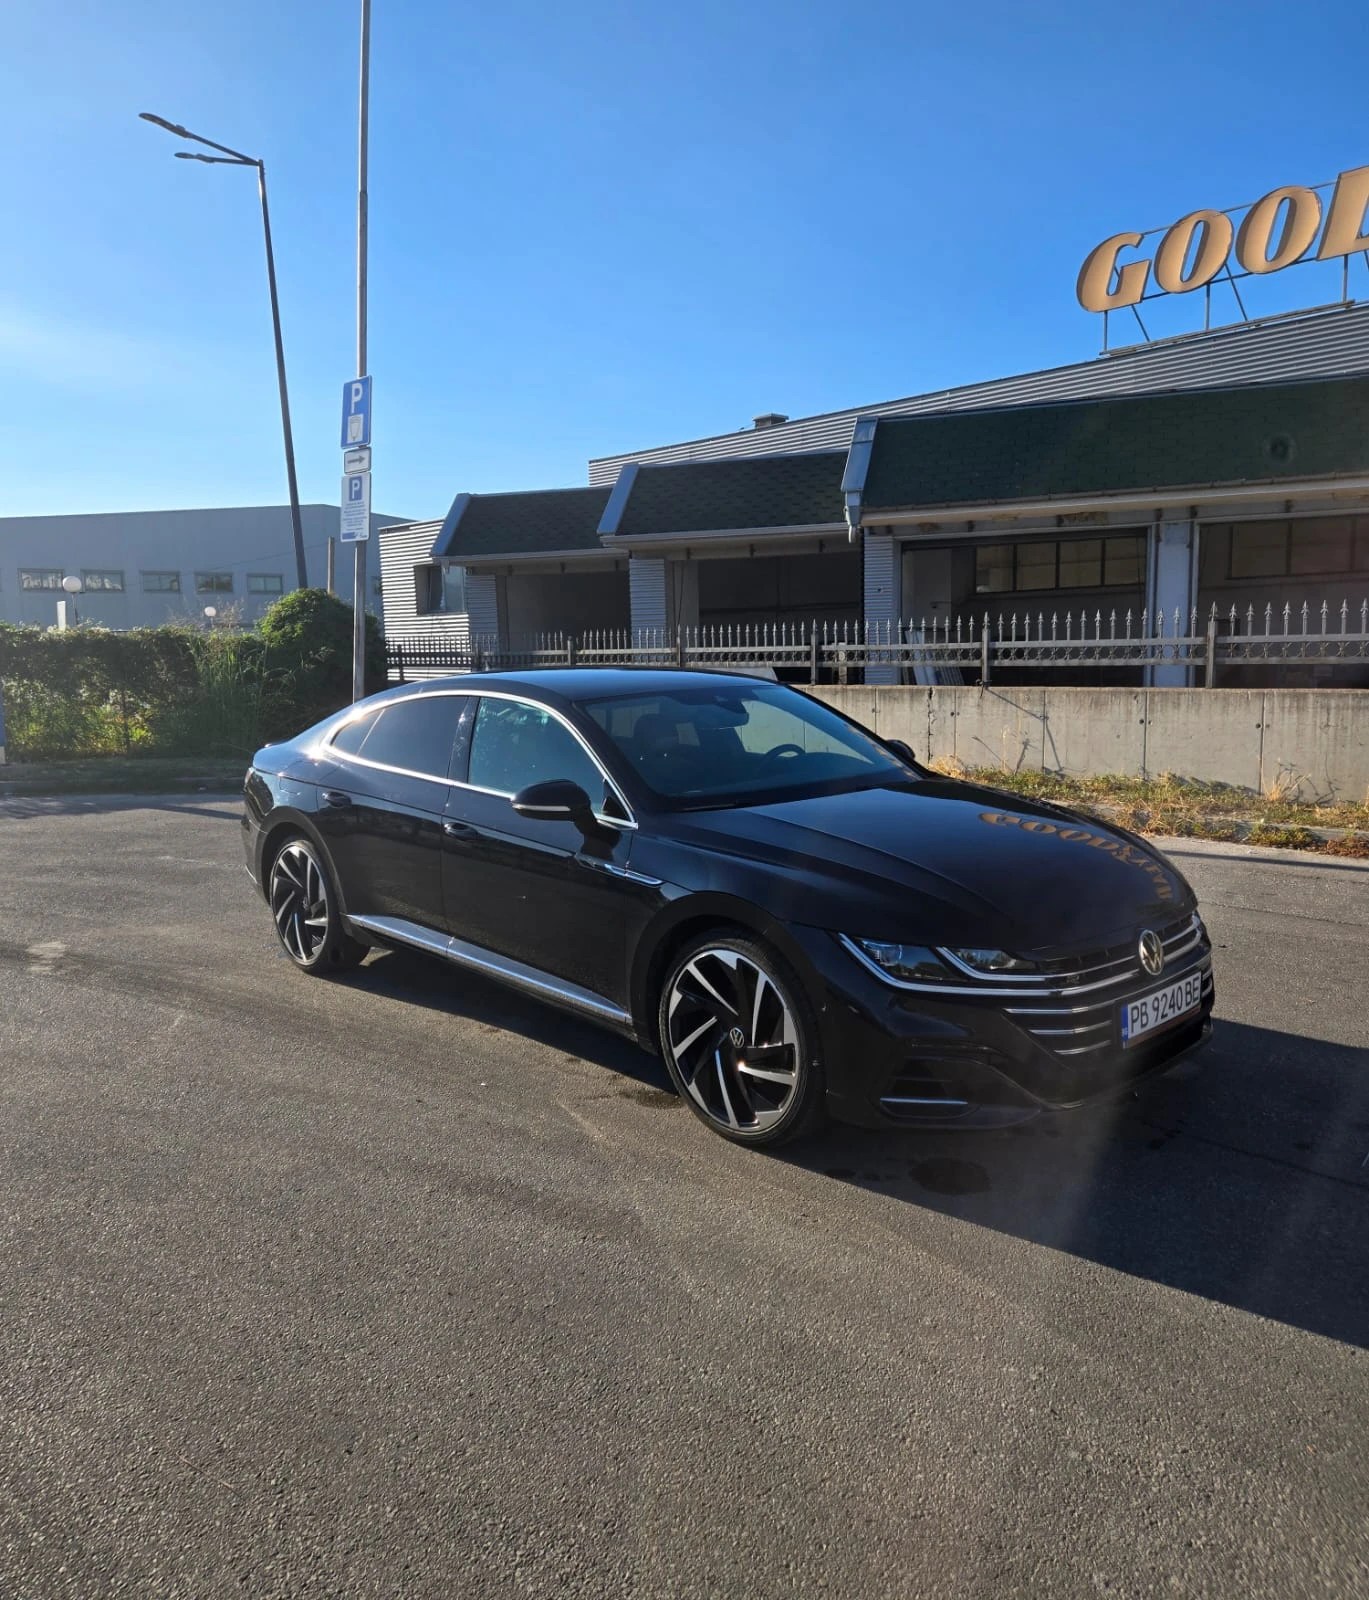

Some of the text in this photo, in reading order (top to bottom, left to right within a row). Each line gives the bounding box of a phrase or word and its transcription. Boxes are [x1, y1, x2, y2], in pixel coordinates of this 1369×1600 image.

[351, 382, 363, 414] P
[351, 478, 360, 500] P
[1130, 977, 1200, 1033] PB 9240 BE
